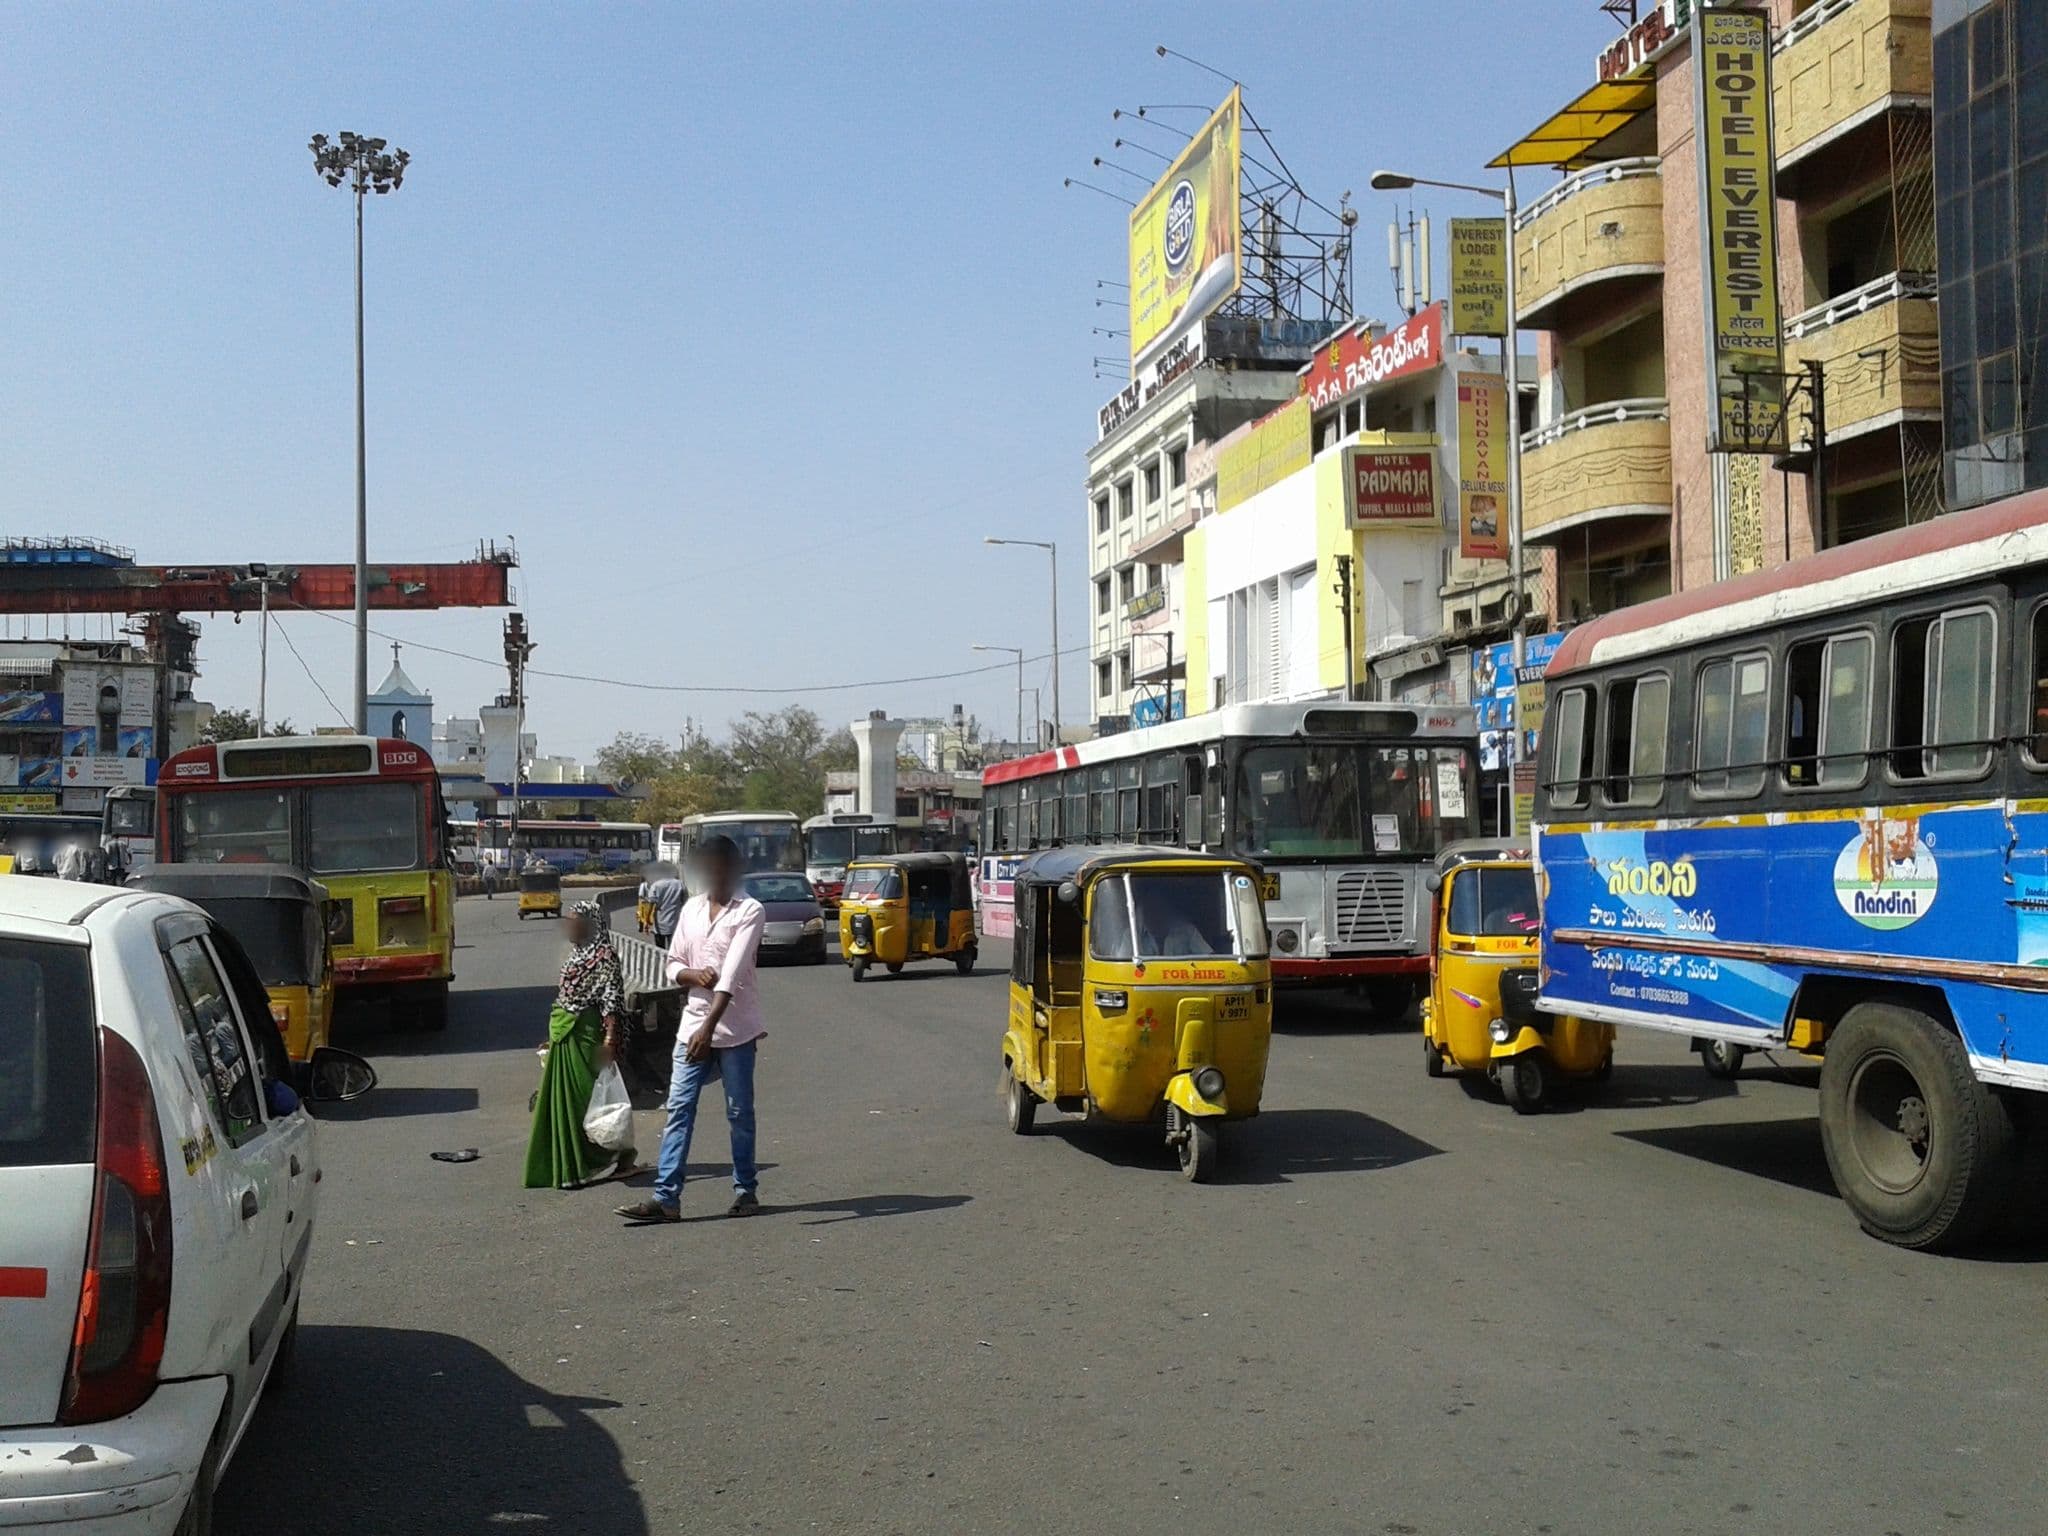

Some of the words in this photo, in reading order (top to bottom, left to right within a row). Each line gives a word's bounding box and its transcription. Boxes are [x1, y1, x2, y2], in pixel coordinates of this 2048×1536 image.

[1599, 5, 1675, 80] HOTEL
[1715, 52, 1756, 156] HOTEL
[1454, 228, 1503, 241] EVEREST
[1721, 167, 1763, 312] EVEREST
[1460, 243, 1497, 256] LODGE
[1475, 388, 1490, 480] BRUNDAVAN
[1374, 455, 1411, 466] HOTEL
[1359, 469, 1430, 497] PADMAJA
[1461, 479, 1486, 493] DELUXE
[1487, 482, 1505, 493] MESS
[385, 753, 416, 764] BDG
[1608, 858, 1697, 897] నందిని
[1855, 891, 1917, 914] Nandini
[1590, 904, 1616, 926] పాలు
[1496, 940, 1518, 949] FOR
[1163, 970, 1189, 980] FOR
[1193, 970, 1225, 980] HIRE
[1610, 983, 1635, 998] Contact
